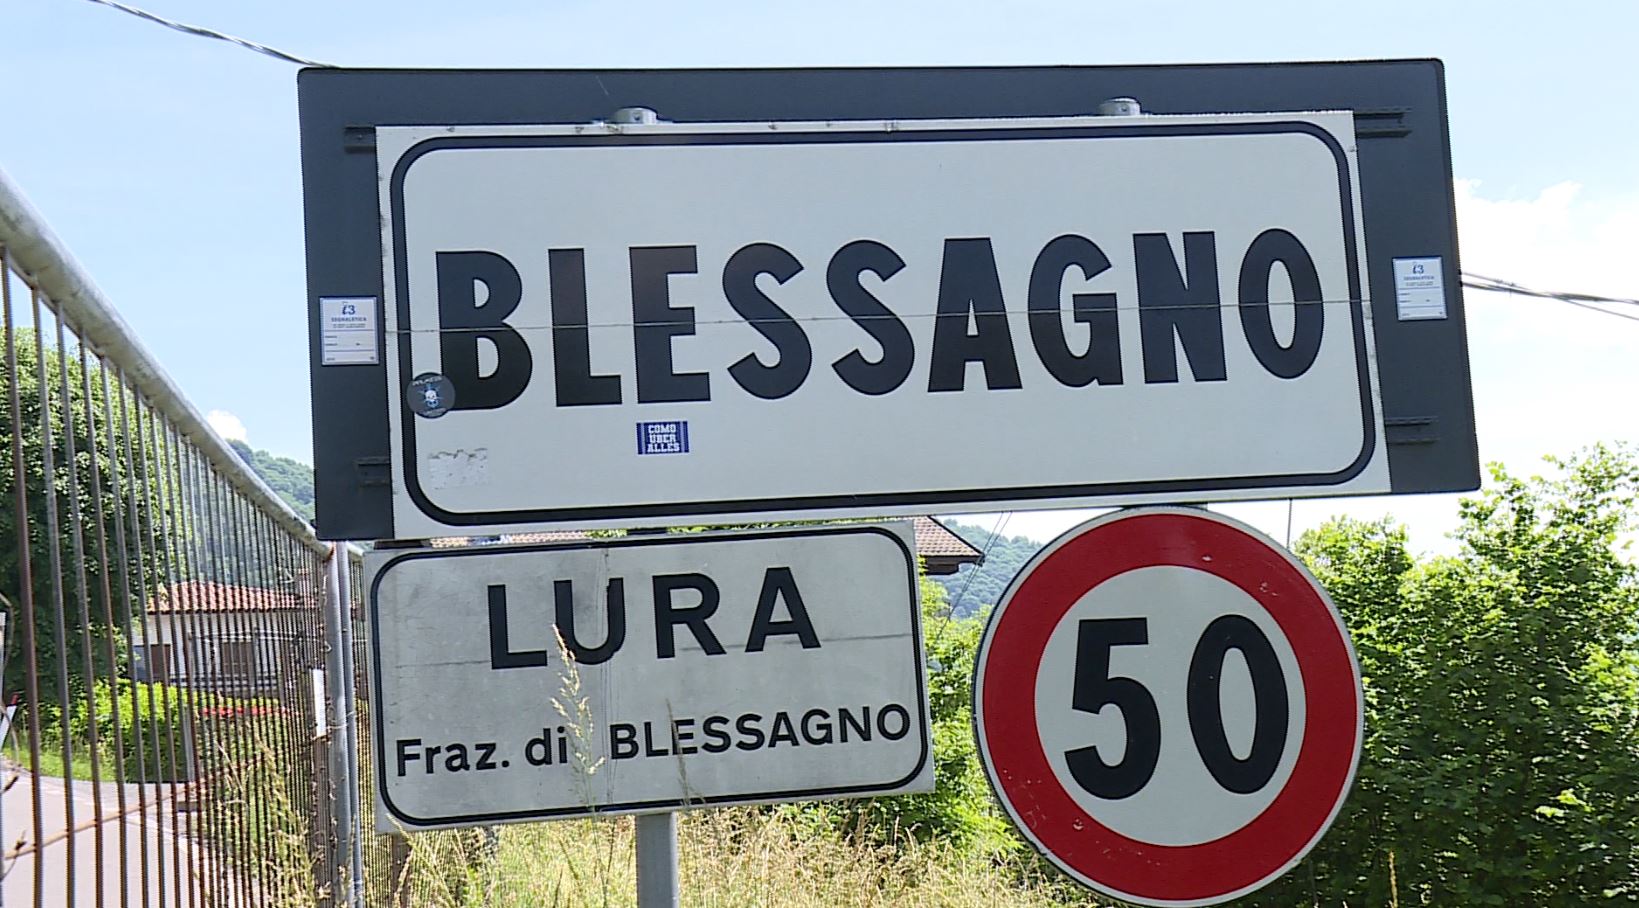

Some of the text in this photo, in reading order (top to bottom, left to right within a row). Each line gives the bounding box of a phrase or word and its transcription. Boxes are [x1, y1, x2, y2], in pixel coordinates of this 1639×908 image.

[435, 229, 1324, 411] BLESSAGNO
[647, 442, 680, 453] ALLES
[648, 423, 677, 434] COMO
[487, 567, 821, 671] LURA
[396, 704, 908, 777] Fraz. di BLESSAGNO
[1064, 614, 1289, 801] 50
